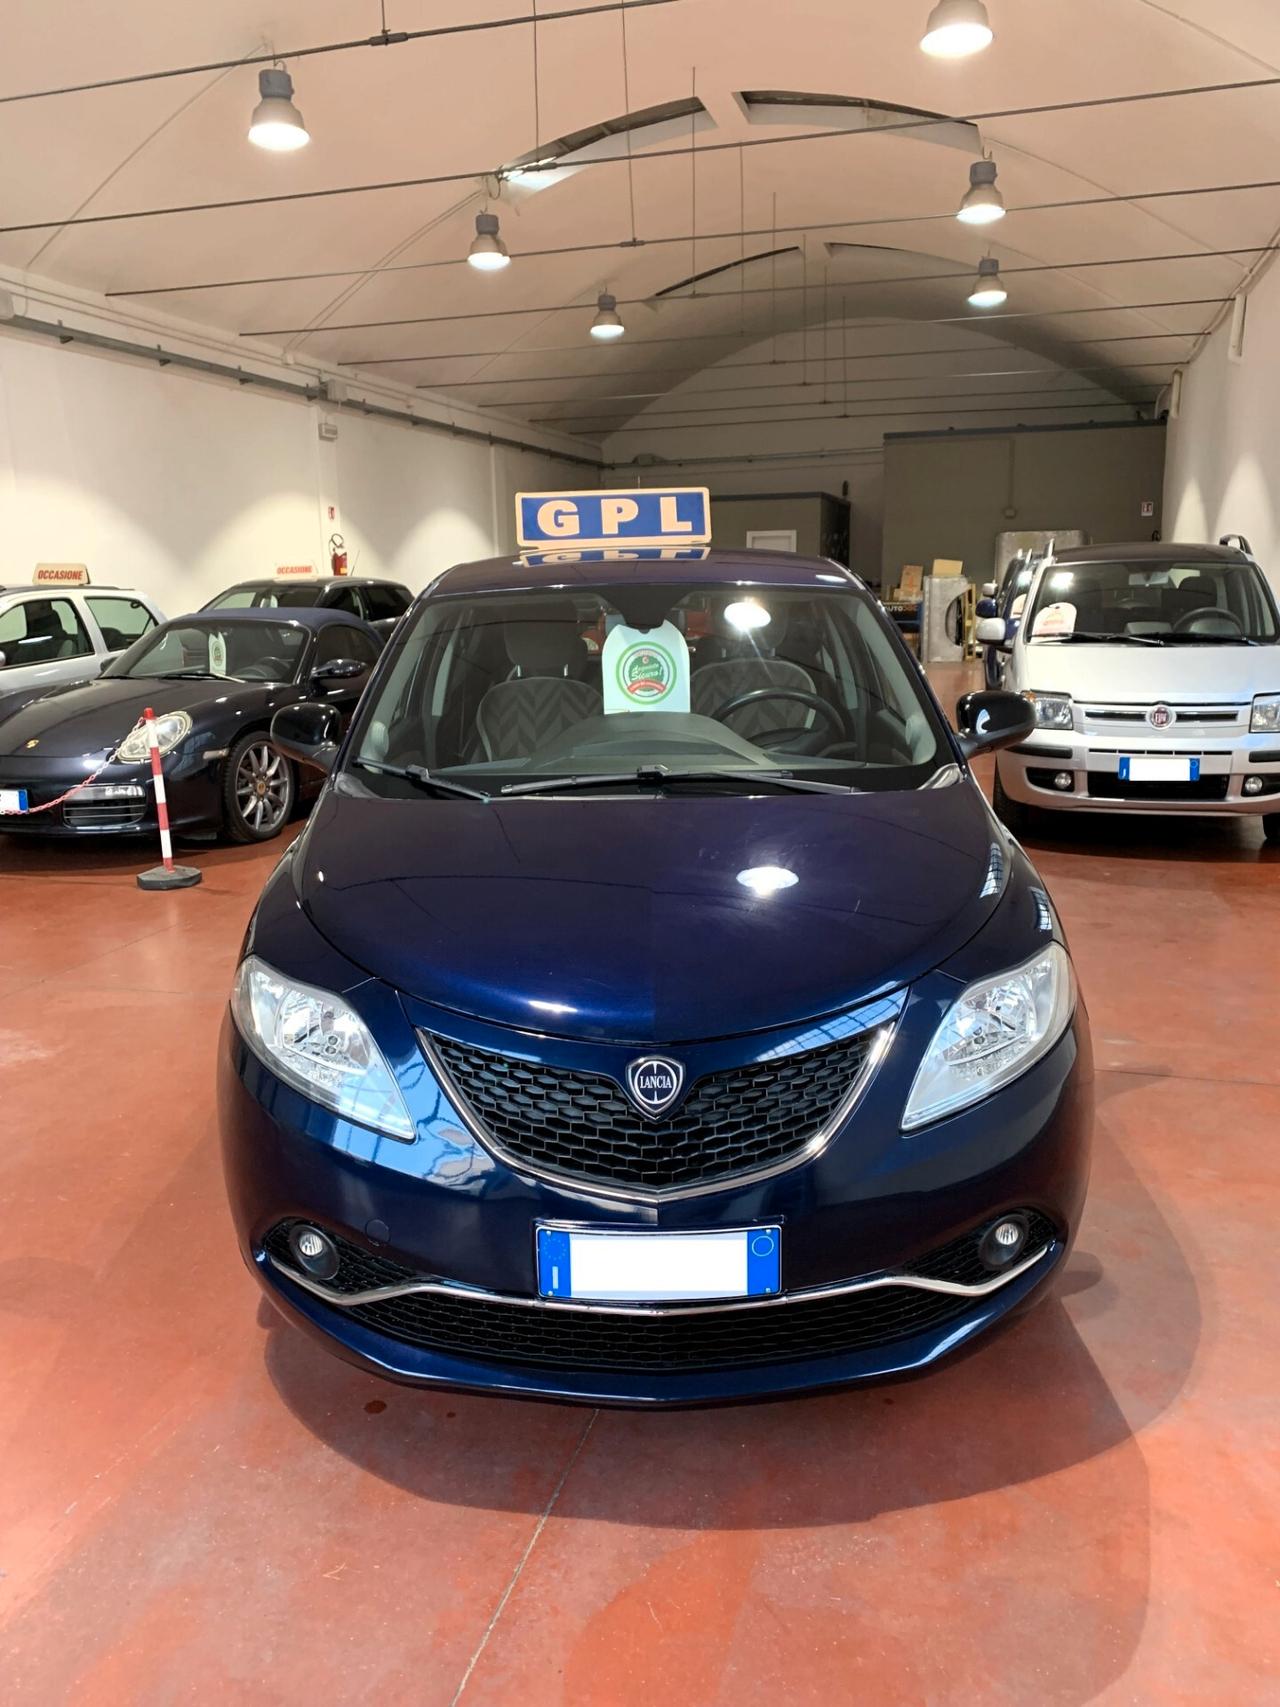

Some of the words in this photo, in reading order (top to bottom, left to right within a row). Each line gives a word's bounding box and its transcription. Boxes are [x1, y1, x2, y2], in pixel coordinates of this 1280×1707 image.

[37, 569, 84, 580] OCCASIONE
[276, 565, 313, 575] OCCASIONE
[640, 1075, 672, 1089] LANCIA
[552, 1266, 559, 1289] I
